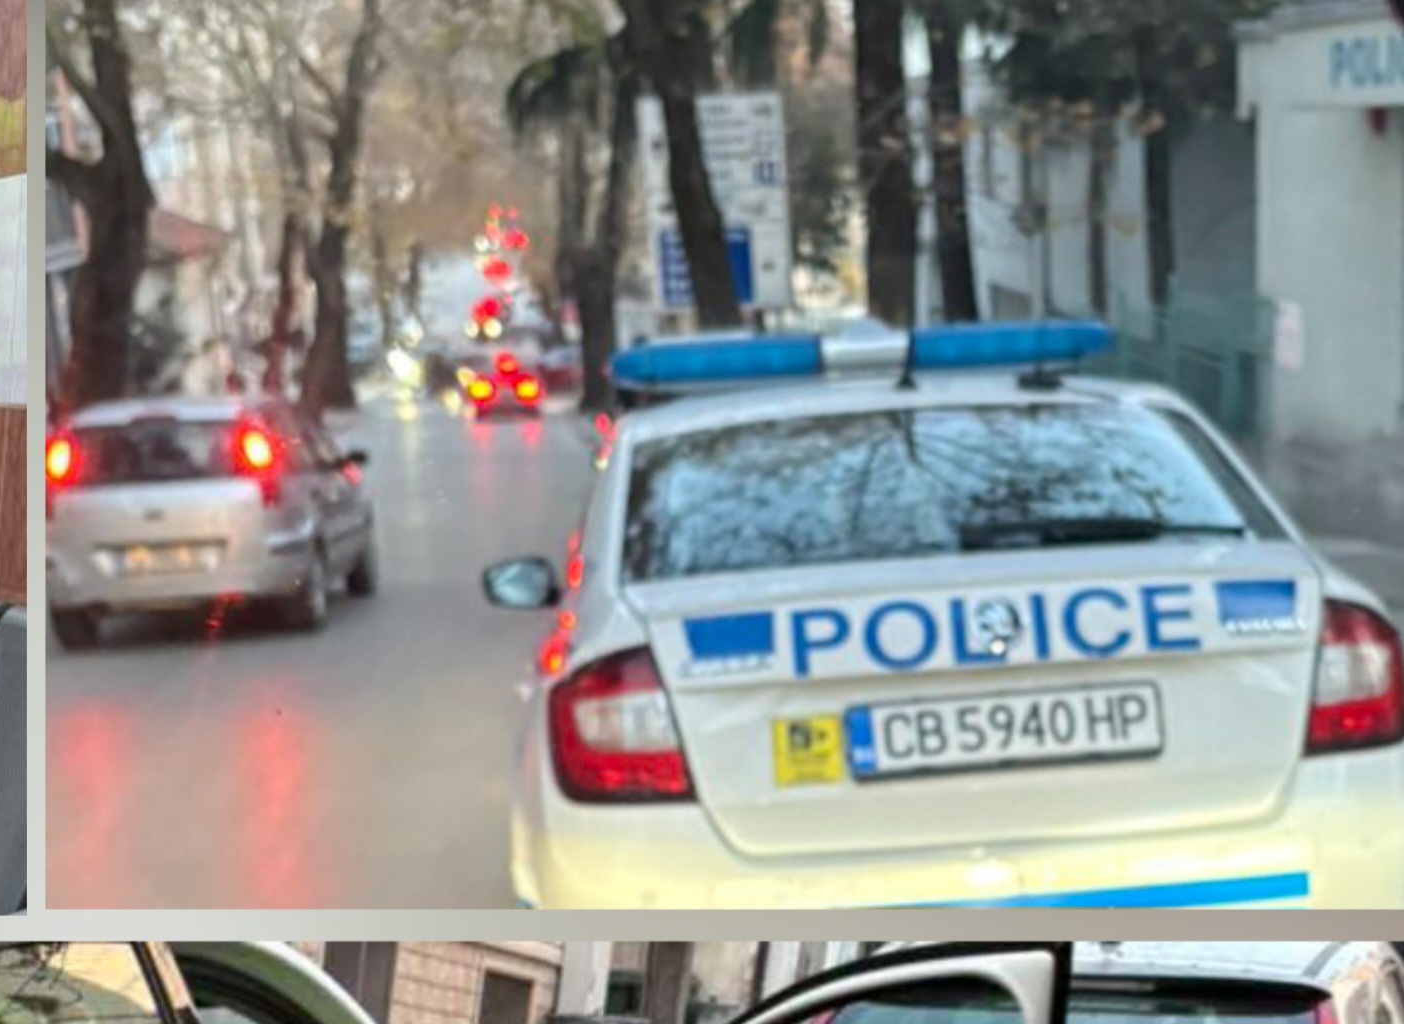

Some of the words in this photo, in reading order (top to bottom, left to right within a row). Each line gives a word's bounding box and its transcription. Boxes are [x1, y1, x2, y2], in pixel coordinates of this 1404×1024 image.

[789, 585, 1202, 678] POLICE
[956, 702, 1076, 753] 5940
[1085, 694, 1148, 742] HP
